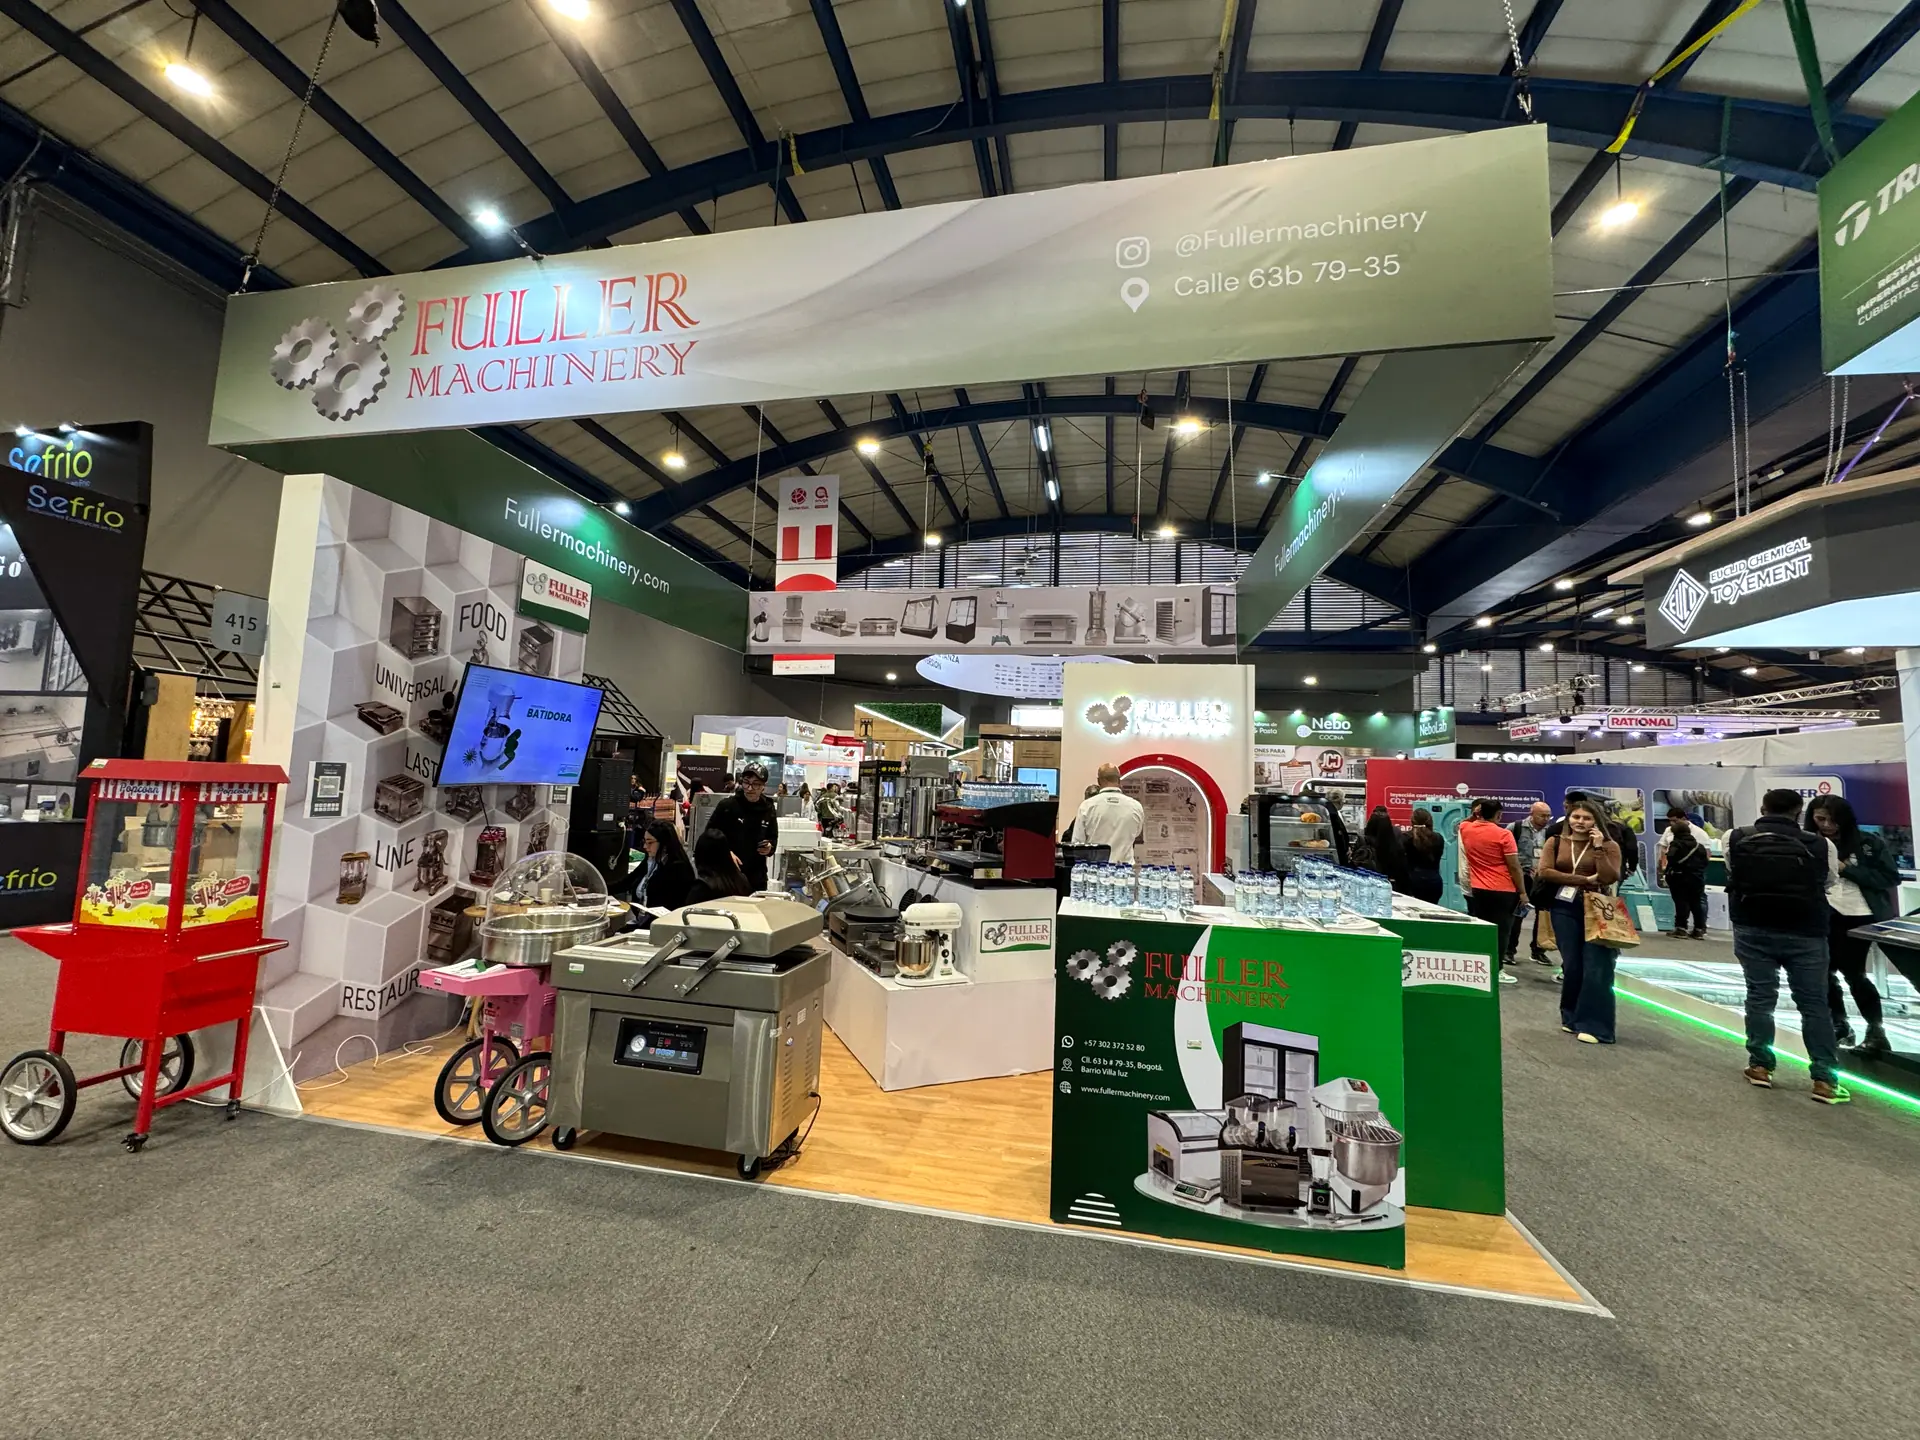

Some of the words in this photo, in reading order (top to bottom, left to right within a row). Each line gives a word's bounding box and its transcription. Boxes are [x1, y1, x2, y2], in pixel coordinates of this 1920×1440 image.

[1175, 210, 1427, 258] @Fullermachinery
[1174, 272, 1240, 297] Calle
[1248, 265, 1303, 289] 63b
[1858, 280, 1919, 326] CUBIERTAS
[410, 271, 700, 357] FULLER
[406, 340, 699, 399] MACHINERY
[504, 498, 670, 593] Fullermachinery.com
[1709, 560, 1747, 584] EUCLID
[1747, 537, 1812, 570] CHEMICAL
[1711, 554, 1812, 605] TOXEMENT
[548, 589, 587, 609] MACHINERY
[549, 578, 589, 602] FULLER
[225, 613, 258, 632] 415
[459, 602, 507, 641] FOOD
[231, 634, 242, 646] a
[376, 662, 446, 703] UNIVERSAL
[527, 708, 572, 723] BATIDORA
[1312, 717, 1351, 730] Nebo
[1610, 717, 1675, 727] RATIONAL
[1419, 719, 1448, 737] NeboLab
[1511, 726, 1538, 737] RATIONAL
[761, 738, 775, 747] JUSTO
[119, 782, 161, 795] Popcorn
[217, 787, 254, 796] Popcorn
[375, 838, 416, 873] LINE
[1009, 924, 1049, 935] FULLER
[1144, 952, 1290, 989] FULLER
[1416, 956, 1488, 974] FULLER
[1416, 971, 1488, 984] MACHINERY
[1143, 983, 1290, 1010] MACHINERY
[1098, 1041, 1111, 1049] 302
[1112, 1042, 1125, 1050] 372
[1126, 1043, 1135, 1051] 52
[1136, 1044, 1145, 1052] 80
[1081, 1066, 1102, 1074] Barrio
[1102, 1067, 1117, 1076] Villa
[1117, 1068, 1128, 1077] luz
[1092, 1057, 1102, 1065] 63
[1115, 1060, 1136, 1069] 79-35,
[1137, 1062, 1163, 1072] Bogotá.
[1081, 1085, 1171, 1101] www.fullermachinery.com
